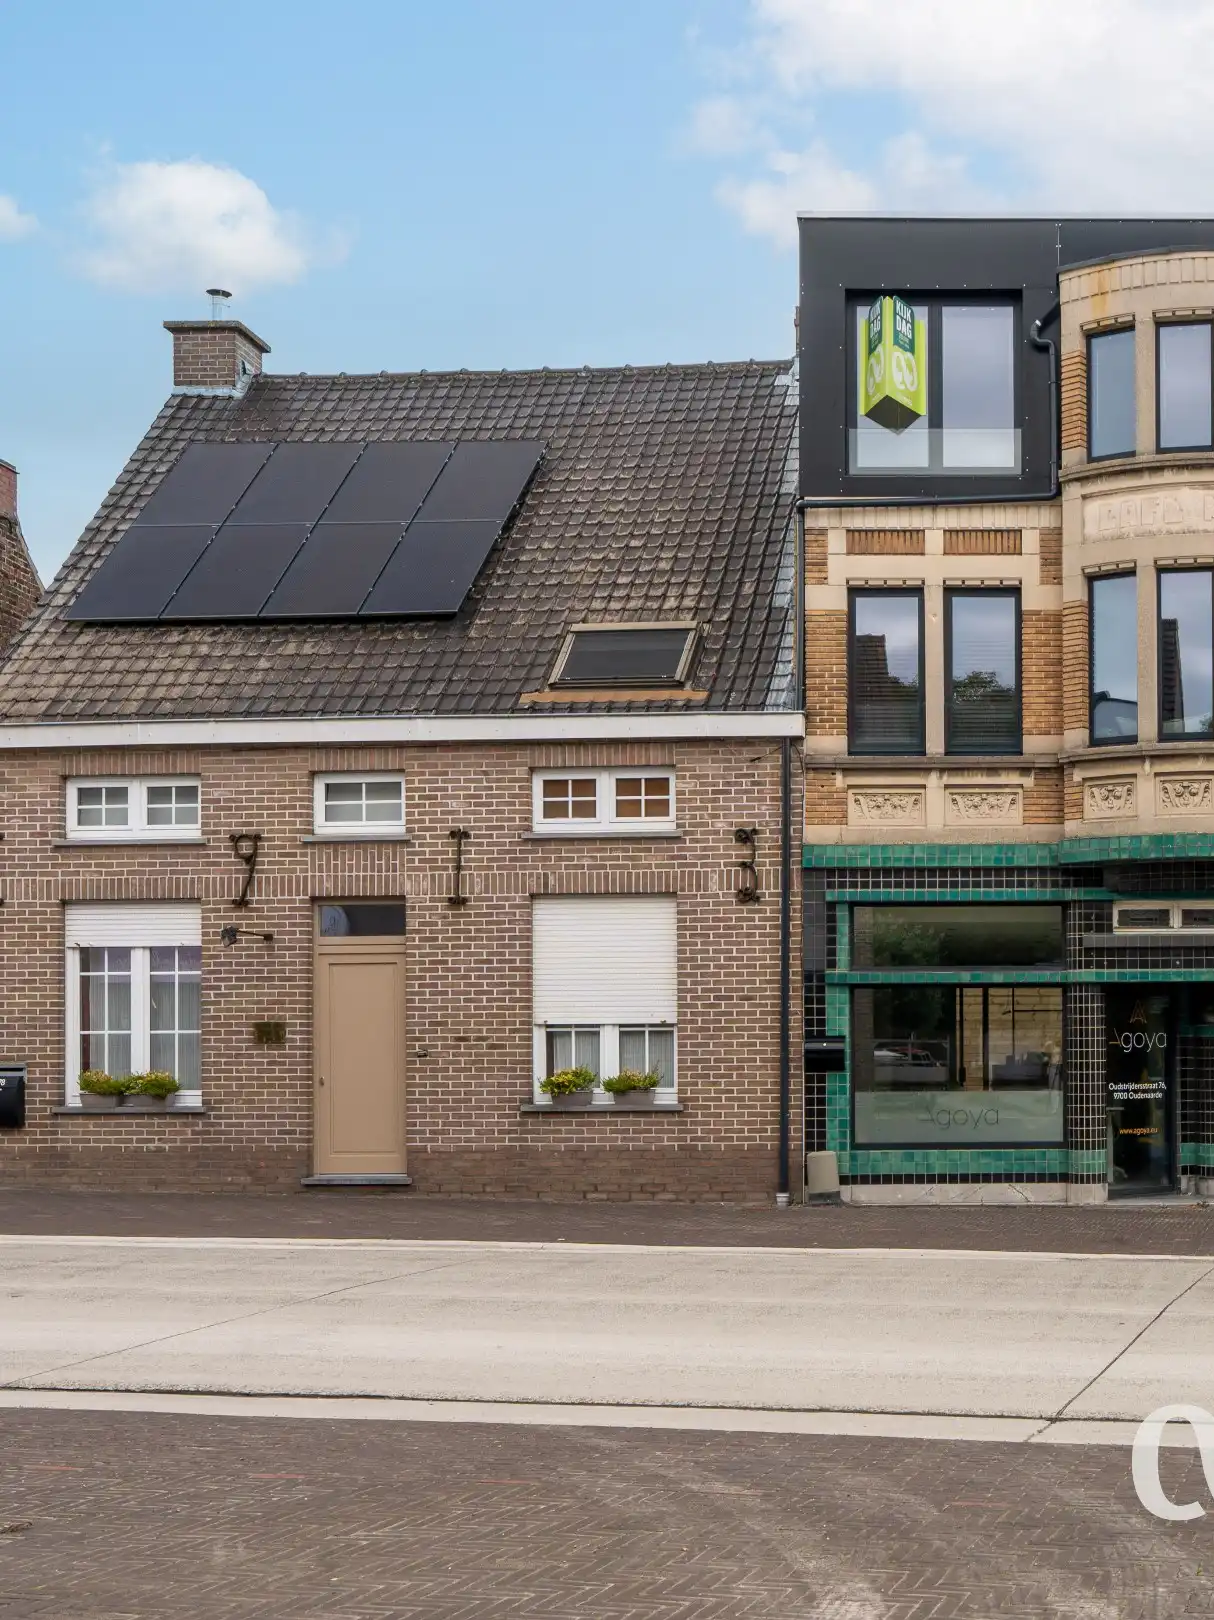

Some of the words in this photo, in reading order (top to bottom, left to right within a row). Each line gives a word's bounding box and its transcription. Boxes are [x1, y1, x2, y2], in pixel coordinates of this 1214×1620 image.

[896, 300, 912, 322] KIJK
[896, 315, 912, 340] DAG
[1108, 1082, 1158, 1091] Oudstrijdersstraat
[1113, 1092, 1128, 1100] 9700
[1128, 1091, 1163, 1100] Oudenaarde
[1119, 1127, 1158, 1136] www.agoya.eu
